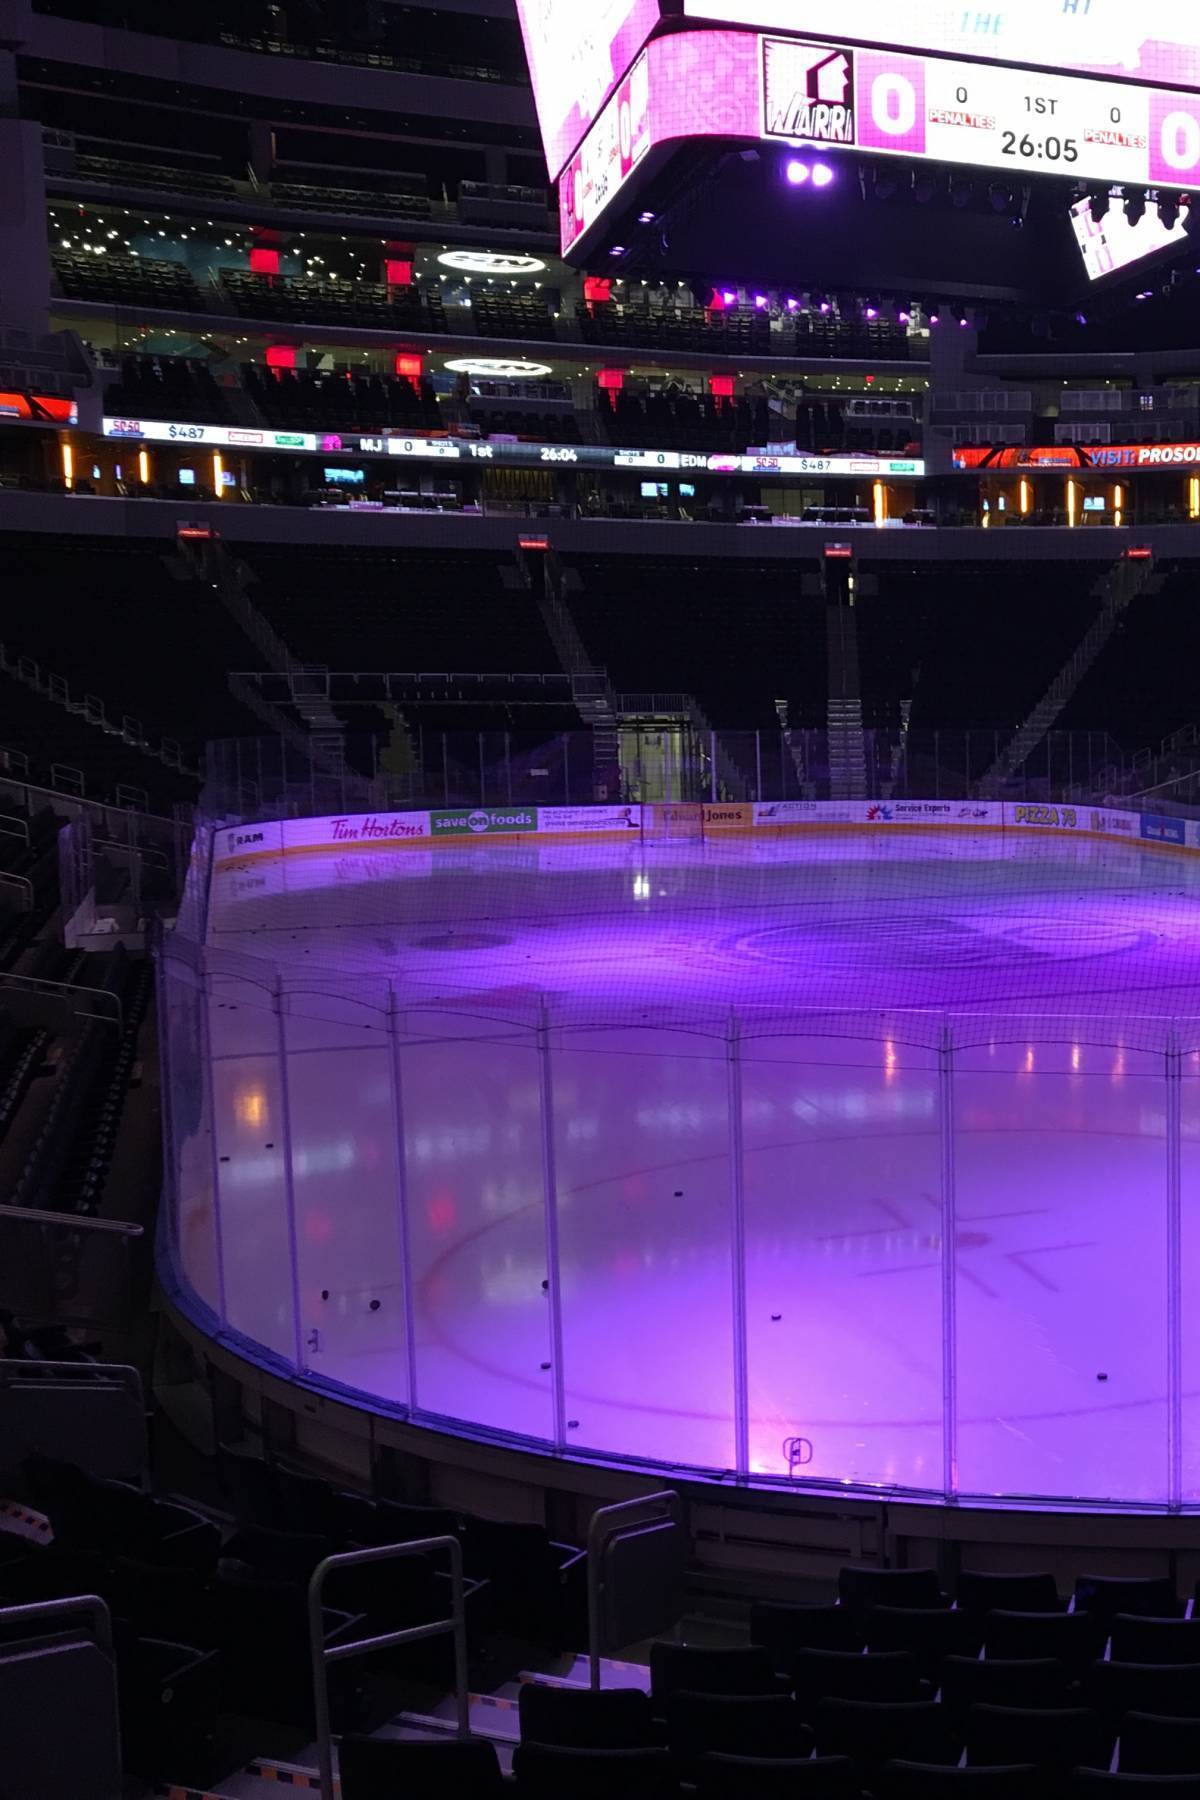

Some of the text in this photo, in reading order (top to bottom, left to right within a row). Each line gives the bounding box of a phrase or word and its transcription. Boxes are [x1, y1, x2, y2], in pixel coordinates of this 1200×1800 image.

[956, 86, 968, 105] 0
[871, 73, 916, 136] 0
[1024, 96, 1058, 116] 1ST
[929, 109, 996, 131] PENALTIES
[1110, 106, 1121, 125] 0
[1001, 130, 1079, 163] 26:05
[1083, 129, 1147, 150] PENALTIES
[1160, 111, 1200, 170] 0
[168, 425, 205, 440] $487
[404, 441, 413, 452] 0
[468, 445, 493, 458] 1st
[540, 448, 578, 462] 26:04
[656, 454, 666, 465] 0
[801, 460, 831, 471] $487
[1090, 449, 1135, 465] VISIT:
[707, 808, 742, 822] Jones
[895, 803, 951, 813] Service Experts
[1015, 806, 1060, 826] PIZZA
[330, 817, 424, 841] Tim Hortons
[435, 817, 467, 829] save
[490, 812, 532, 826] foods
[236, 832, 264, 846] RAM
